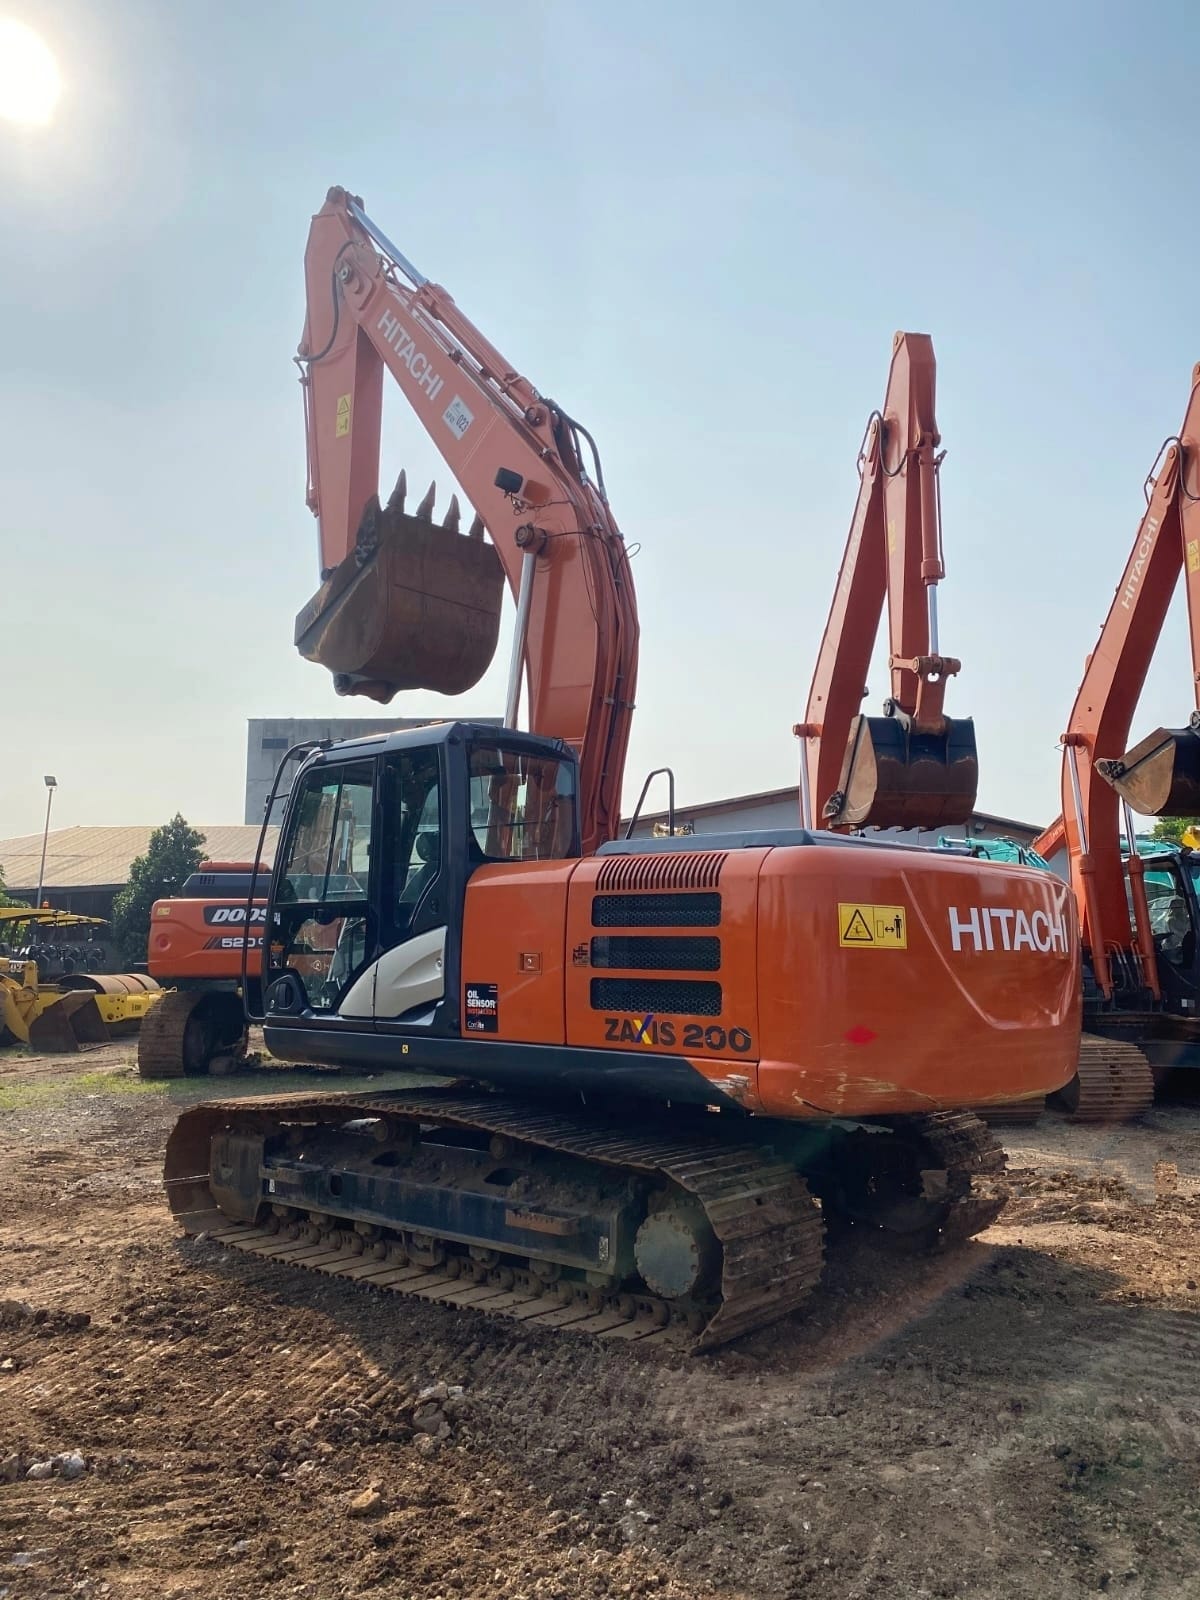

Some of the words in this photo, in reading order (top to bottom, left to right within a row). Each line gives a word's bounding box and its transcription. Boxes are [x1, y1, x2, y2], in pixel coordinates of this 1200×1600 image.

[377, 309, 445, 401] HITACHI
[1121, 516, 1159, 610] HITACHI
[948, 906, 1069, 953] HITACHI
[467, 990, 480, 999] OIL
[467, 998, 496, 1009] SENSOR
[604, 1013, 676, 1046] ZAXIS
[683, 1023, 752, 1052] 200
